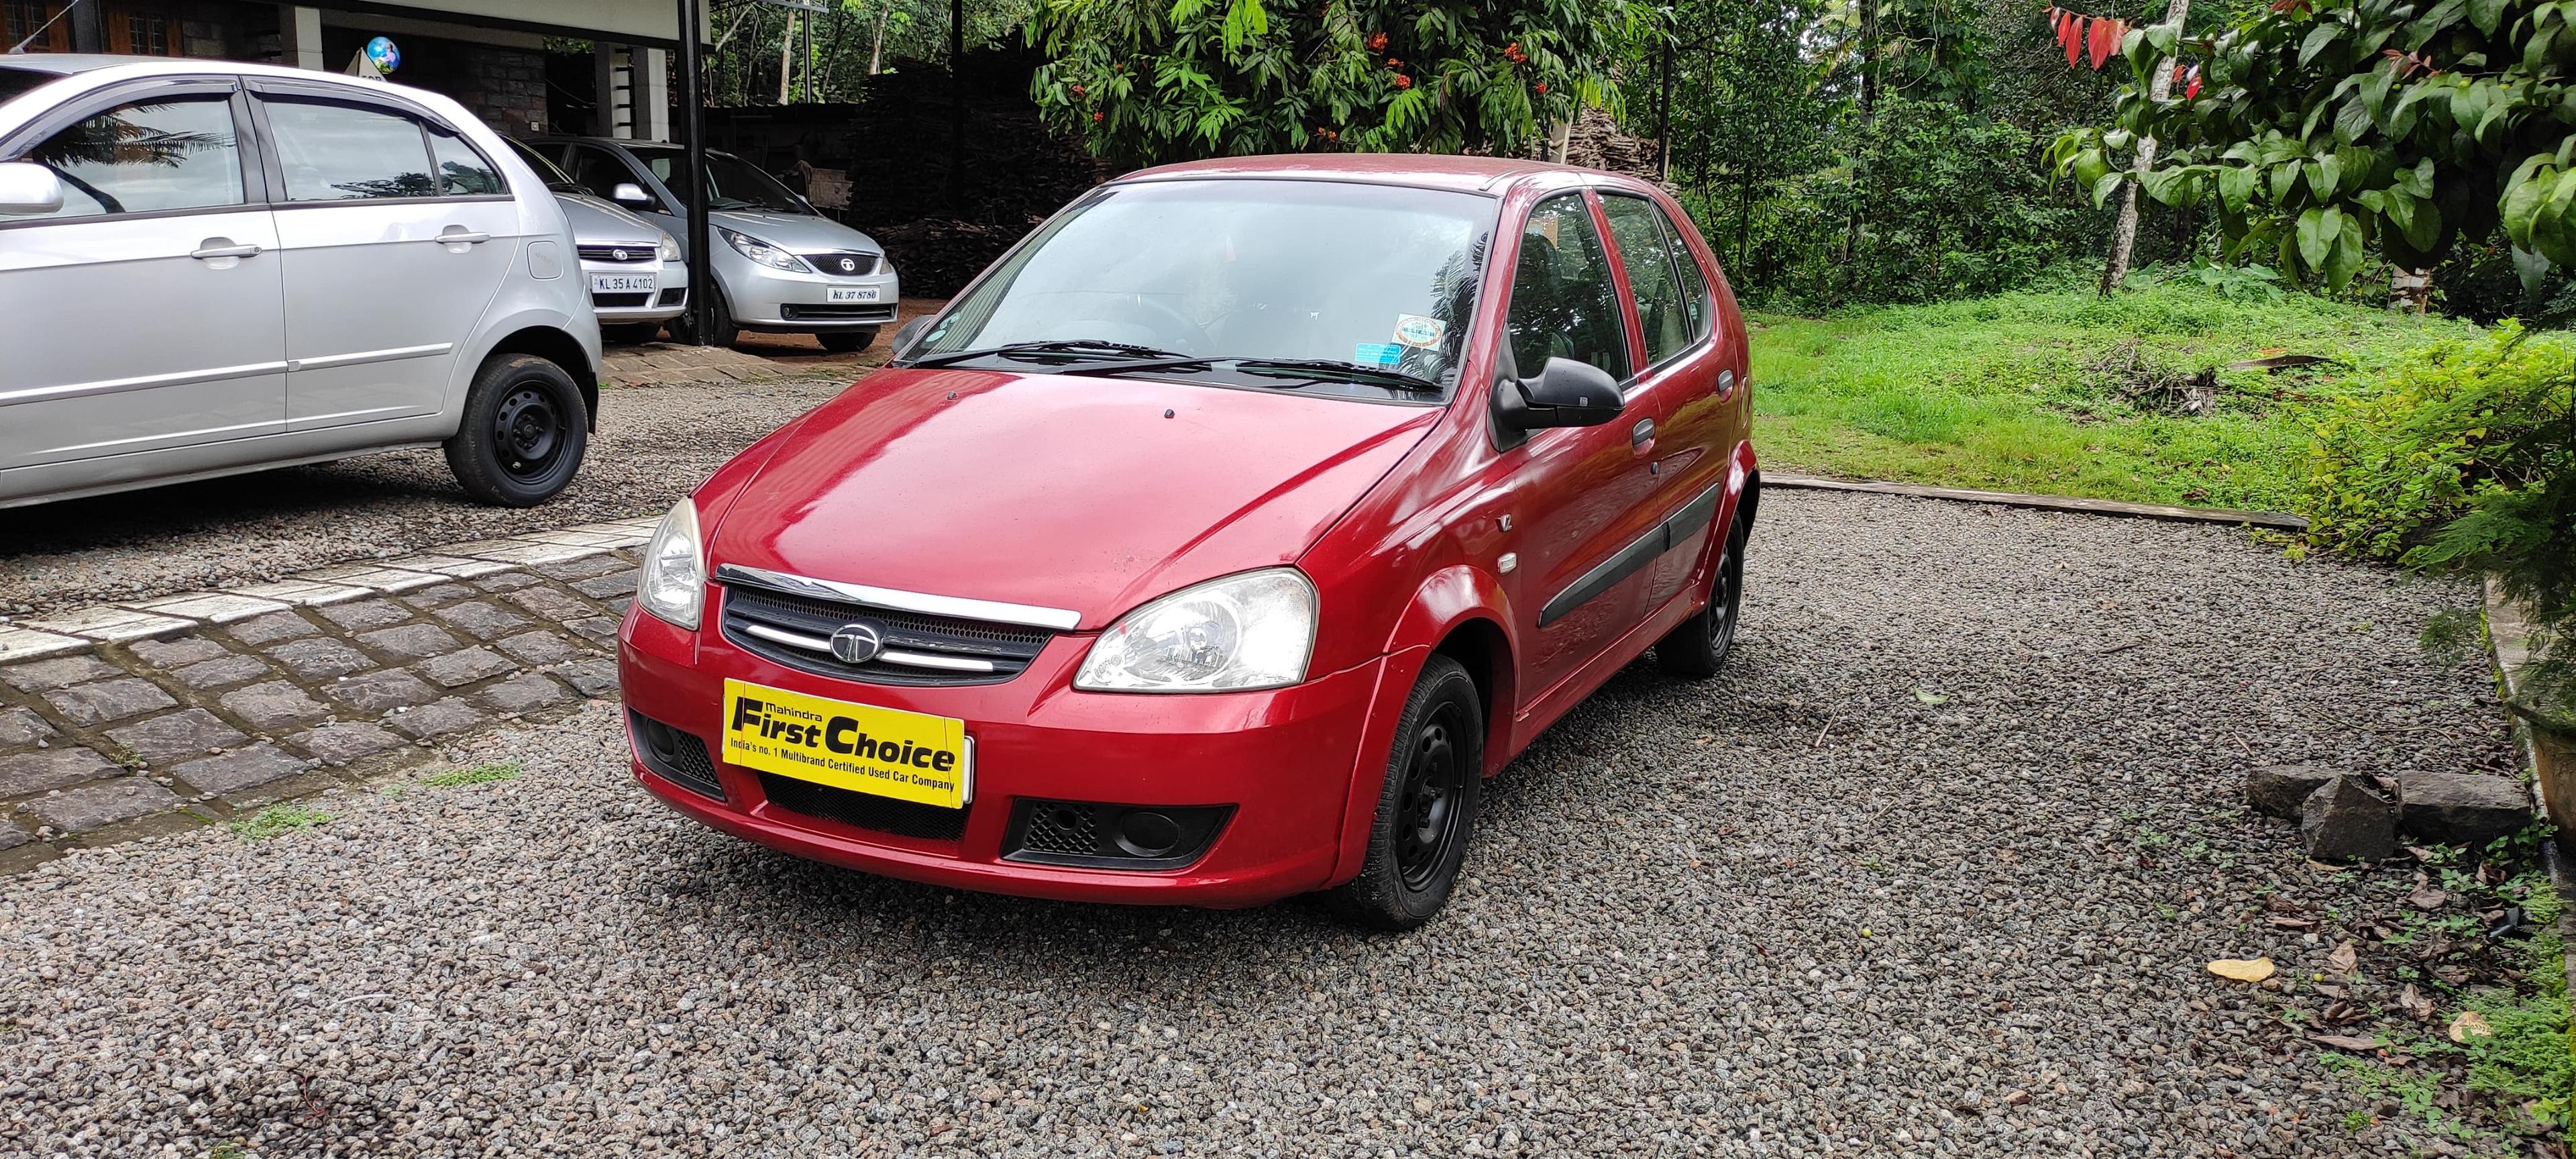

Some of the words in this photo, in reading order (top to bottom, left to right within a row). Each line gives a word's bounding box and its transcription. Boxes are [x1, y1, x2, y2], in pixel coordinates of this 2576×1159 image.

[599, 278, 610, 289] KL
[612, 278, 623, 289] 35
[626, 279, 631, 289] A
[633, 278, 653, 289] 4102
[833, 290, 844, 299] KL
[845, 291, 856, 299] 37
[765, 702, 822, 722] Mahindra
[731, 696, 822, 748] First
[825, 715, 955, 772] Choice
[731, 738, 757, 752] India's
[759, 746, 771, 756] no.
[773, 748, 778, 757] 1
[781, 749, 825, 766] Multibrand
[828, 758, 865, 775] Certified
[868, 767, 890, 779] Used
[893, 771, 909, 783] Car
[912, 774, 955, 792] Company
